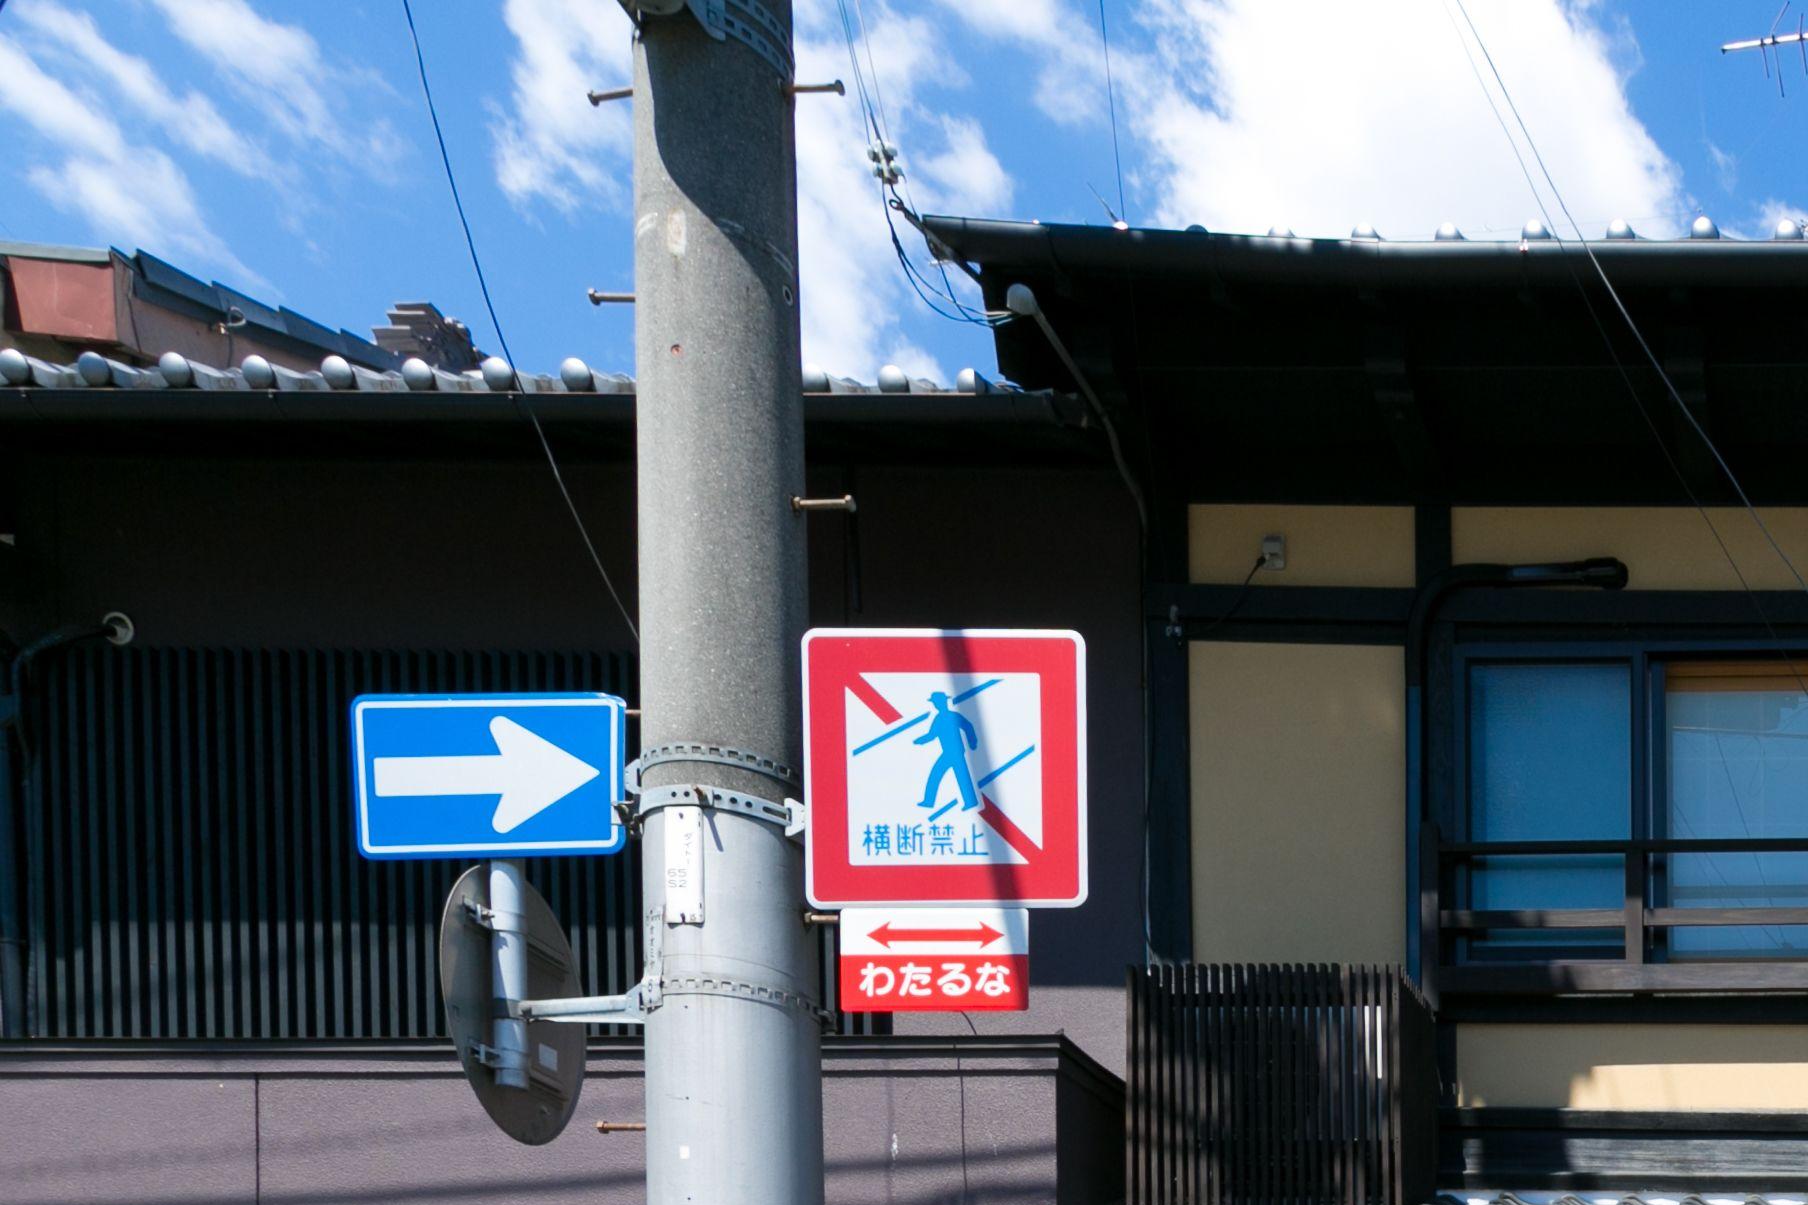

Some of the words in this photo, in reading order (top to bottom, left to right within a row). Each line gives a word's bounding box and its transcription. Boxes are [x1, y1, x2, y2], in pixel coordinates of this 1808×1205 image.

[862, 823, 989, 857] 横断禁止
[667, 868, 688, 878] 65
[859, 961, 1011, 998] わたるな
